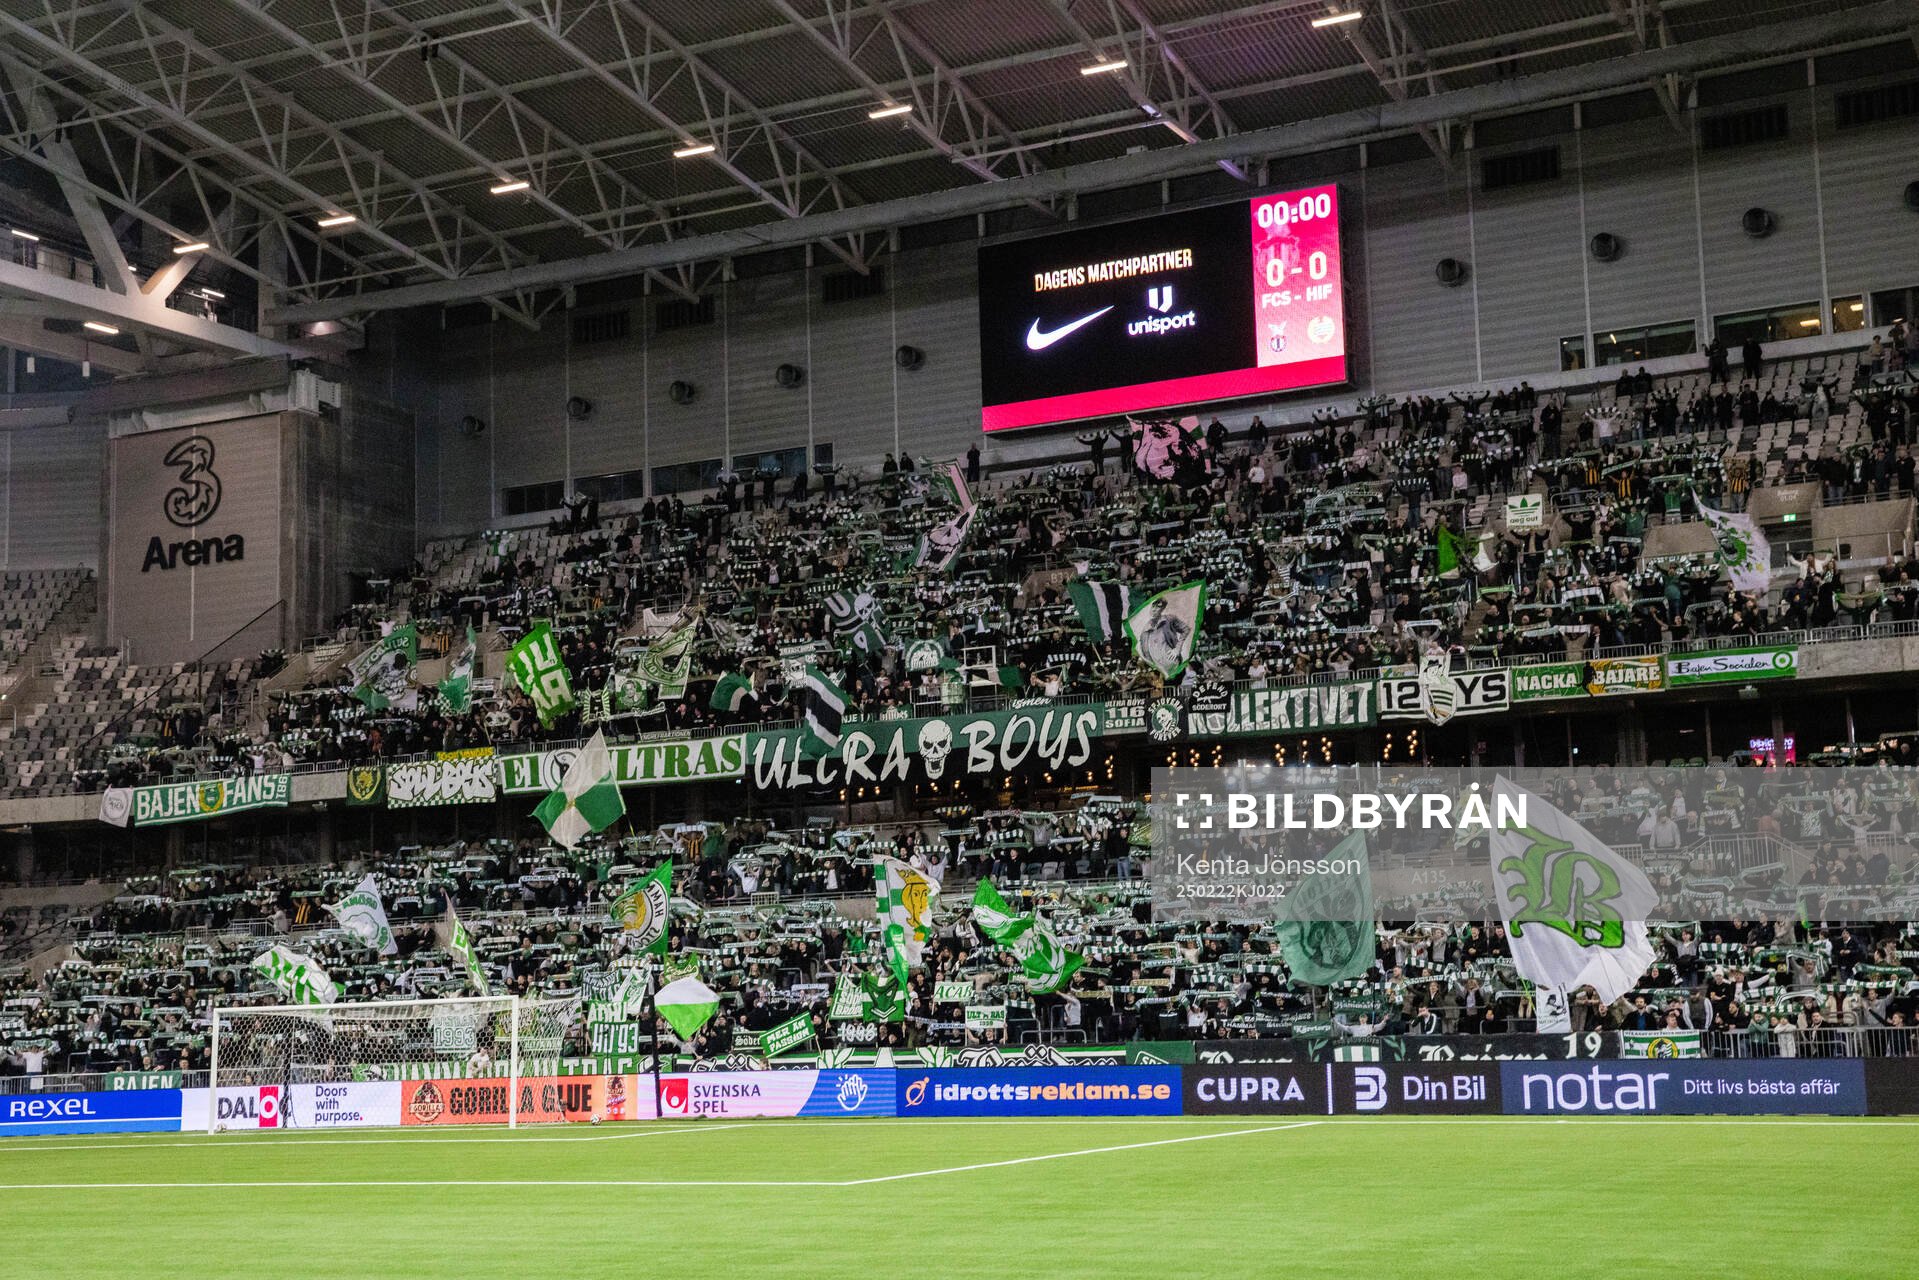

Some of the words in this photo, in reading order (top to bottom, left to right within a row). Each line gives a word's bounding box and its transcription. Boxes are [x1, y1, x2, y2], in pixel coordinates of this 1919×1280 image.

[1257, 193, 1331, 229] 00:00
[1035, 268, 1085, 292] DAGENS
[1087, 248, 1193, 281] MATCHPARTNER
[1266, 259, 1284, 287] 0
[1309, 251, 1327, 280] 0
[1261, 290, 1291, 309] FCS
[1306, 283, 1333, 302] HIF
[1128, 310, 1196, 336] unisport
[141, 533, 244, 572] Arena
[1674, 659, 1712, 679] Bajen
[1713, 656, 1772, 673] Socialen
[1193, 681, 1228, 698] DEFEND
[1516, 672, 1578, 692] NACKA
[1105, 706, 1145, 719] 116
[1105, 718, 1146, 729] SOFIA
[960, 710, 1098, 773] BOYS
[608, 738, 743, 782] LTRAS
[136, 786, 200, 820] BAJEN
[223, 775, 275, 807] FANS
[1412, 870, 1446, 883] A135
[435, 1027, 476, 1047] 1993
[769, 1027, 810, 1052] PASSION
[315, 1085, 348, 1098] Doors
[541, 1083, 592, 1113] GLUE
[694, 1083, 761, 1098] SVENSKA
[934, 1082, 1171, 1101] idrottsreklam.se
[1197, 1077, 1306, 1102] CUPRA
[1403, 1075, 1448, 1101] Din
[1454, 1075, 1486, 1100] Bil
[1523, 1065, 1670, 1111] notar
[1684, 1079, 1713, 1095] Ditt
[1717, 1079, 1744, 1095] livs
[1748, 1079, 1796, 1095] bästa
[1800, 1079, 1840, 1095] affär
[316, 1098, 339, 1110] with
[694, 1099, 729, 1113] SPEL
[315, 1110, 363, 1125] purpose.
